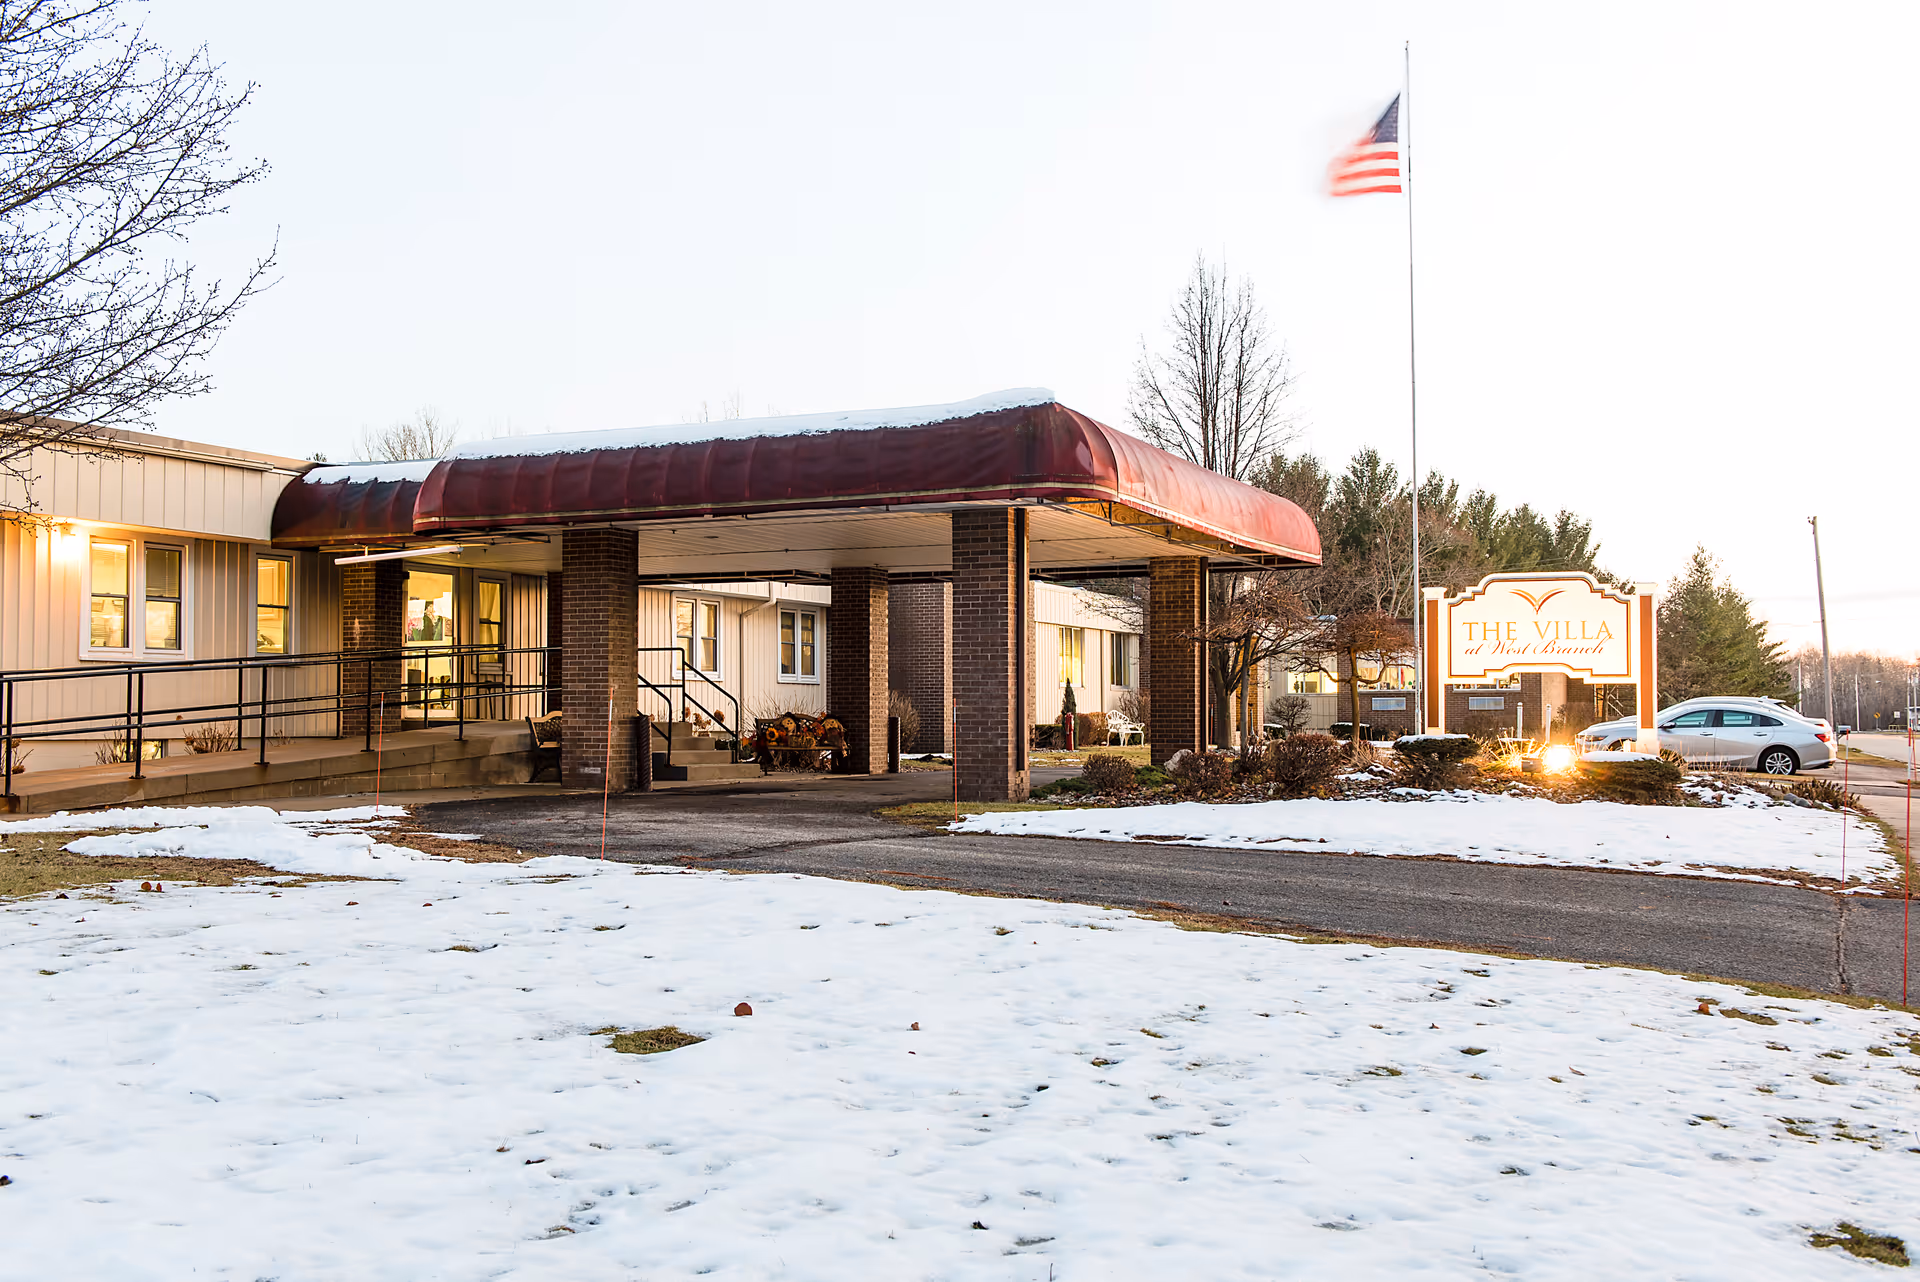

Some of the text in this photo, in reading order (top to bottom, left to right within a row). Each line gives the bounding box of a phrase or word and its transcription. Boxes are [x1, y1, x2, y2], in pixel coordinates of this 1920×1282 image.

[1462, 620, 1614, 641] THE VILLA
[1464, 633, 1612, 655] at West Branch
